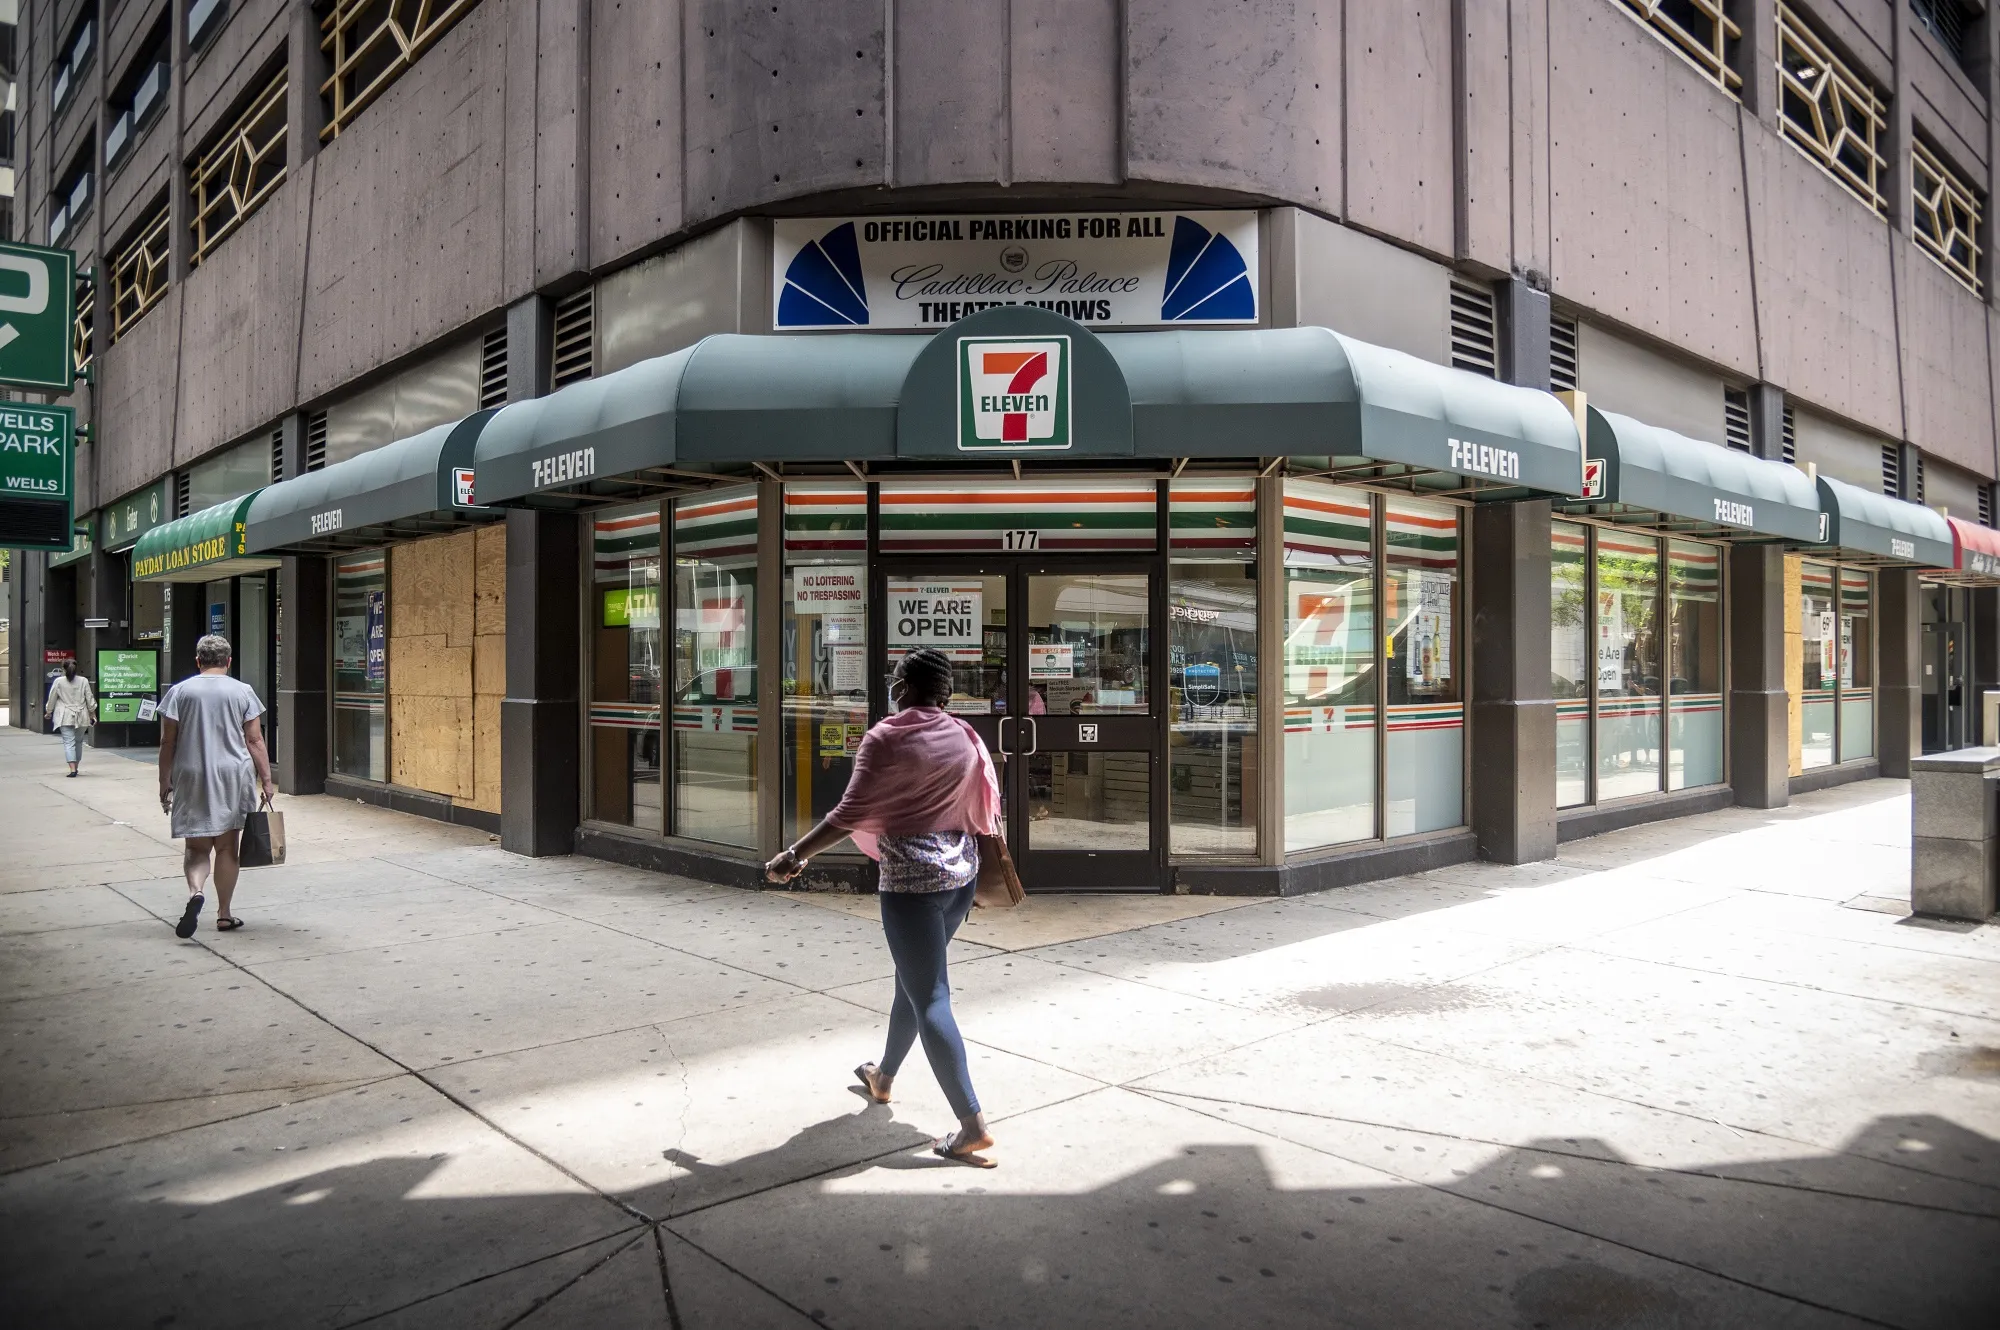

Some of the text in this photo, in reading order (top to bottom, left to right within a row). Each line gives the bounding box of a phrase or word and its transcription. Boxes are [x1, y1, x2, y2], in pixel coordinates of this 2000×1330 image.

[864, 217, 1165, 242] OFFICIAL PARKING FOR ALL
[890, 259, 1140, 300] Cadillac Palace
[982, 351, 1048, 442] 7
[6, 476, 58, 491] WELLS
[1005, 530, 1038, 550] 177
[135, 554, 164, 577] PAYDAY
[165, 546, 190, 570] LOAN
[192, 536, 226, 564] STORE
[803, 575, 855, 587] NO LOITERING
[797, 590, 861, 601] NO TRESPASSING
[623, 592, 657, 619] ATM
[898, 600, 972, 615] WE ARE
[370, 624, 383, 639] ARE
[898, 618, 972, 637] OPEN!
[1605, 646, 1620, 660] Are
